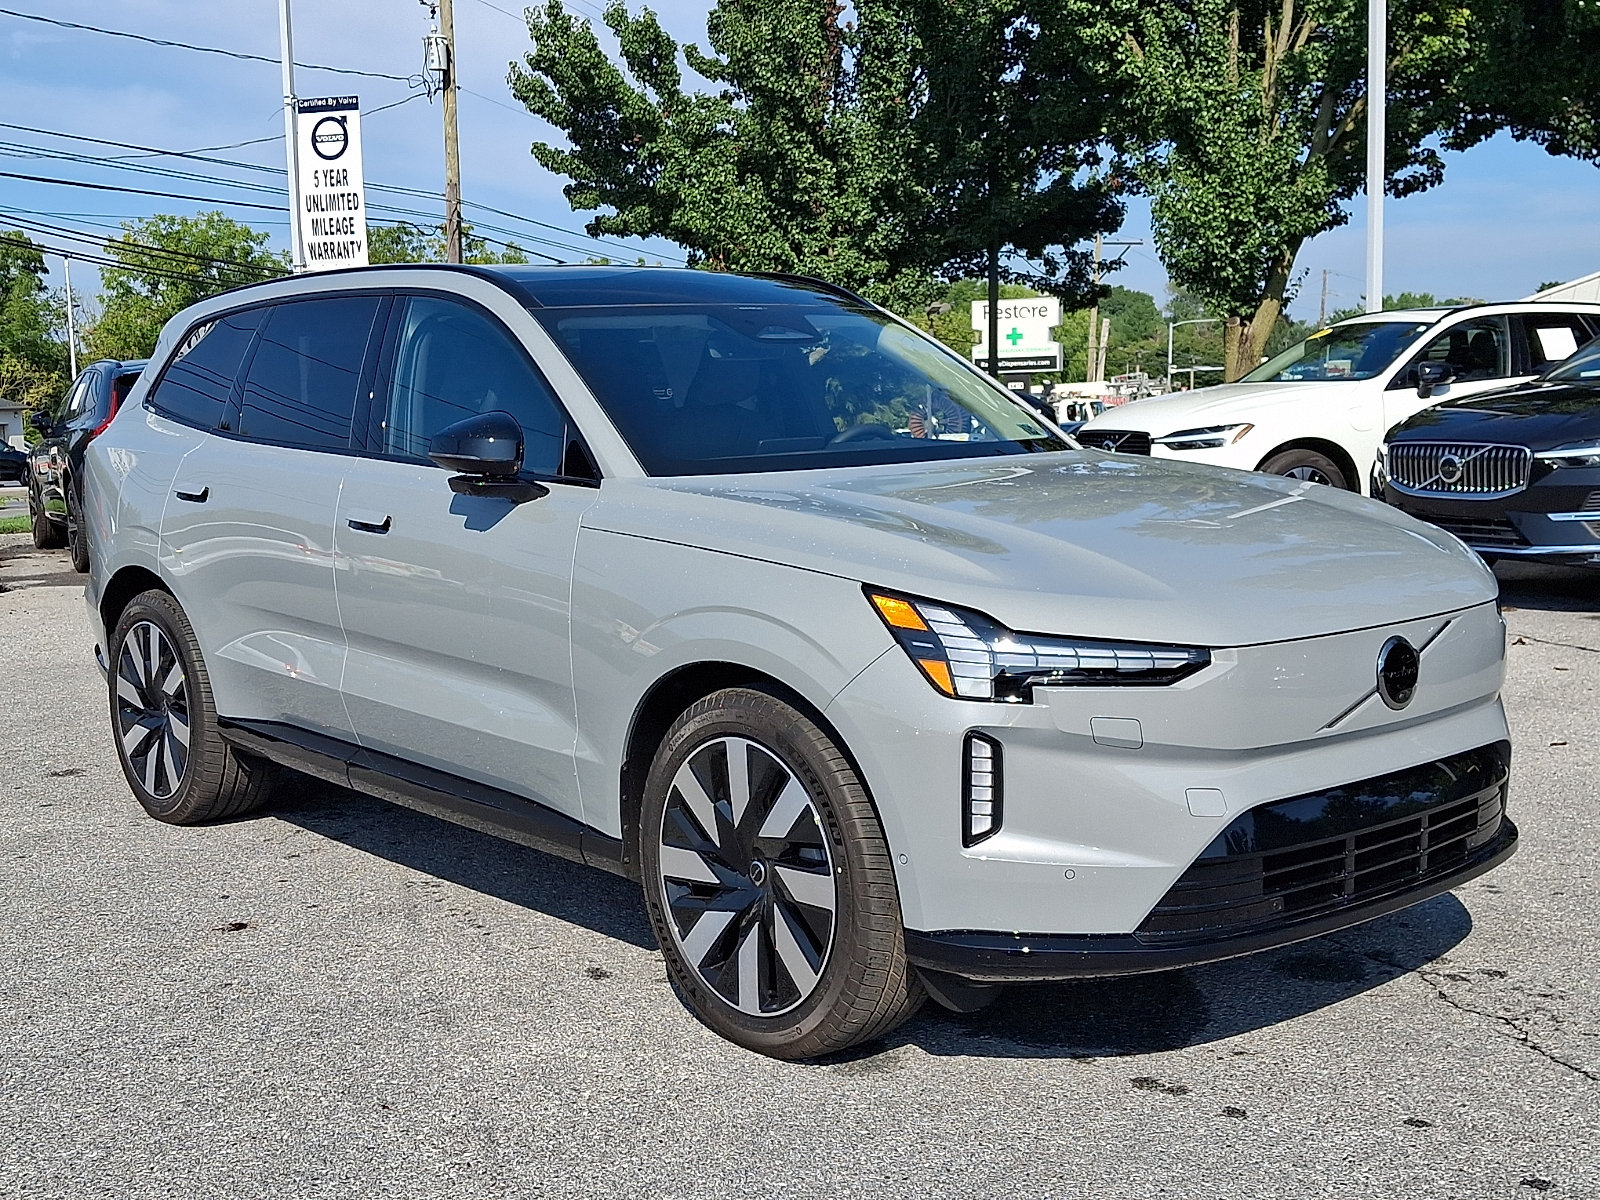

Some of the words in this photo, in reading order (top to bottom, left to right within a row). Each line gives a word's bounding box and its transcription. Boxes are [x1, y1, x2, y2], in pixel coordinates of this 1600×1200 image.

[299, 99, 326, 107] Certified
[328, 97, 337, 107] By
[316, 134, 345, 142] VOLVO
[314, 170, 320, 188] 5
[322, 168, 348, 187] YEAR
[305, 192, 359, 213] UNLIMITED
[311, 216, 355, 237] MILEAGE
[308, 240, 362, 261] WARRANTY
